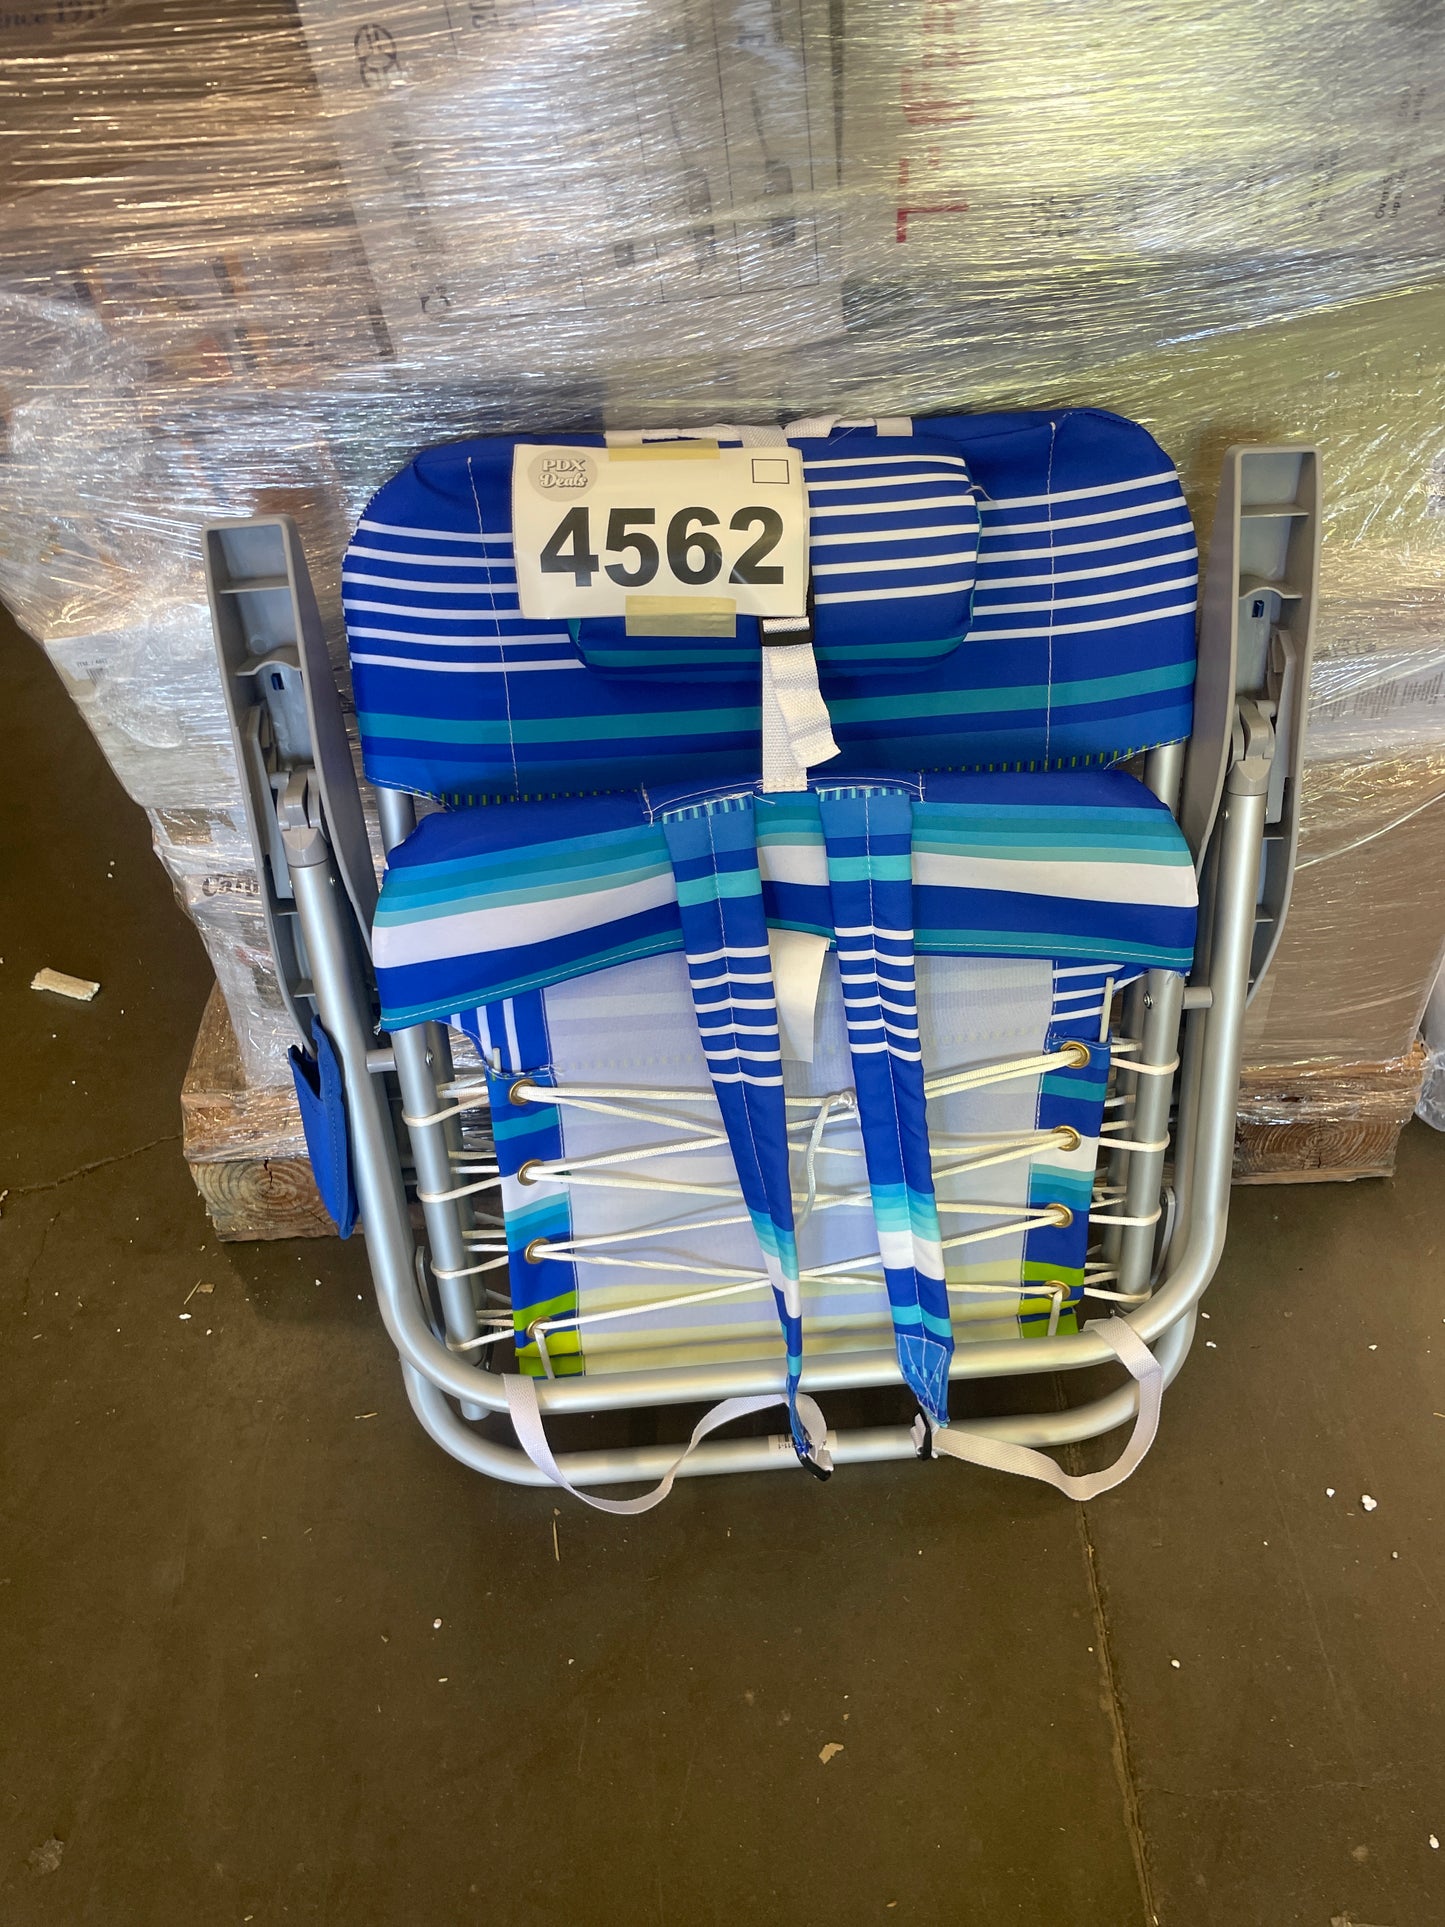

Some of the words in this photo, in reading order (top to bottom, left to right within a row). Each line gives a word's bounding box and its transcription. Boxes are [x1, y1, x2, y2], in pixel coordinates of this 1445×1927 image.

[542, 459, 586, 472] PDX
[540, 472, 588, 488] Deals
[540, 506, 784, 587] 4562
